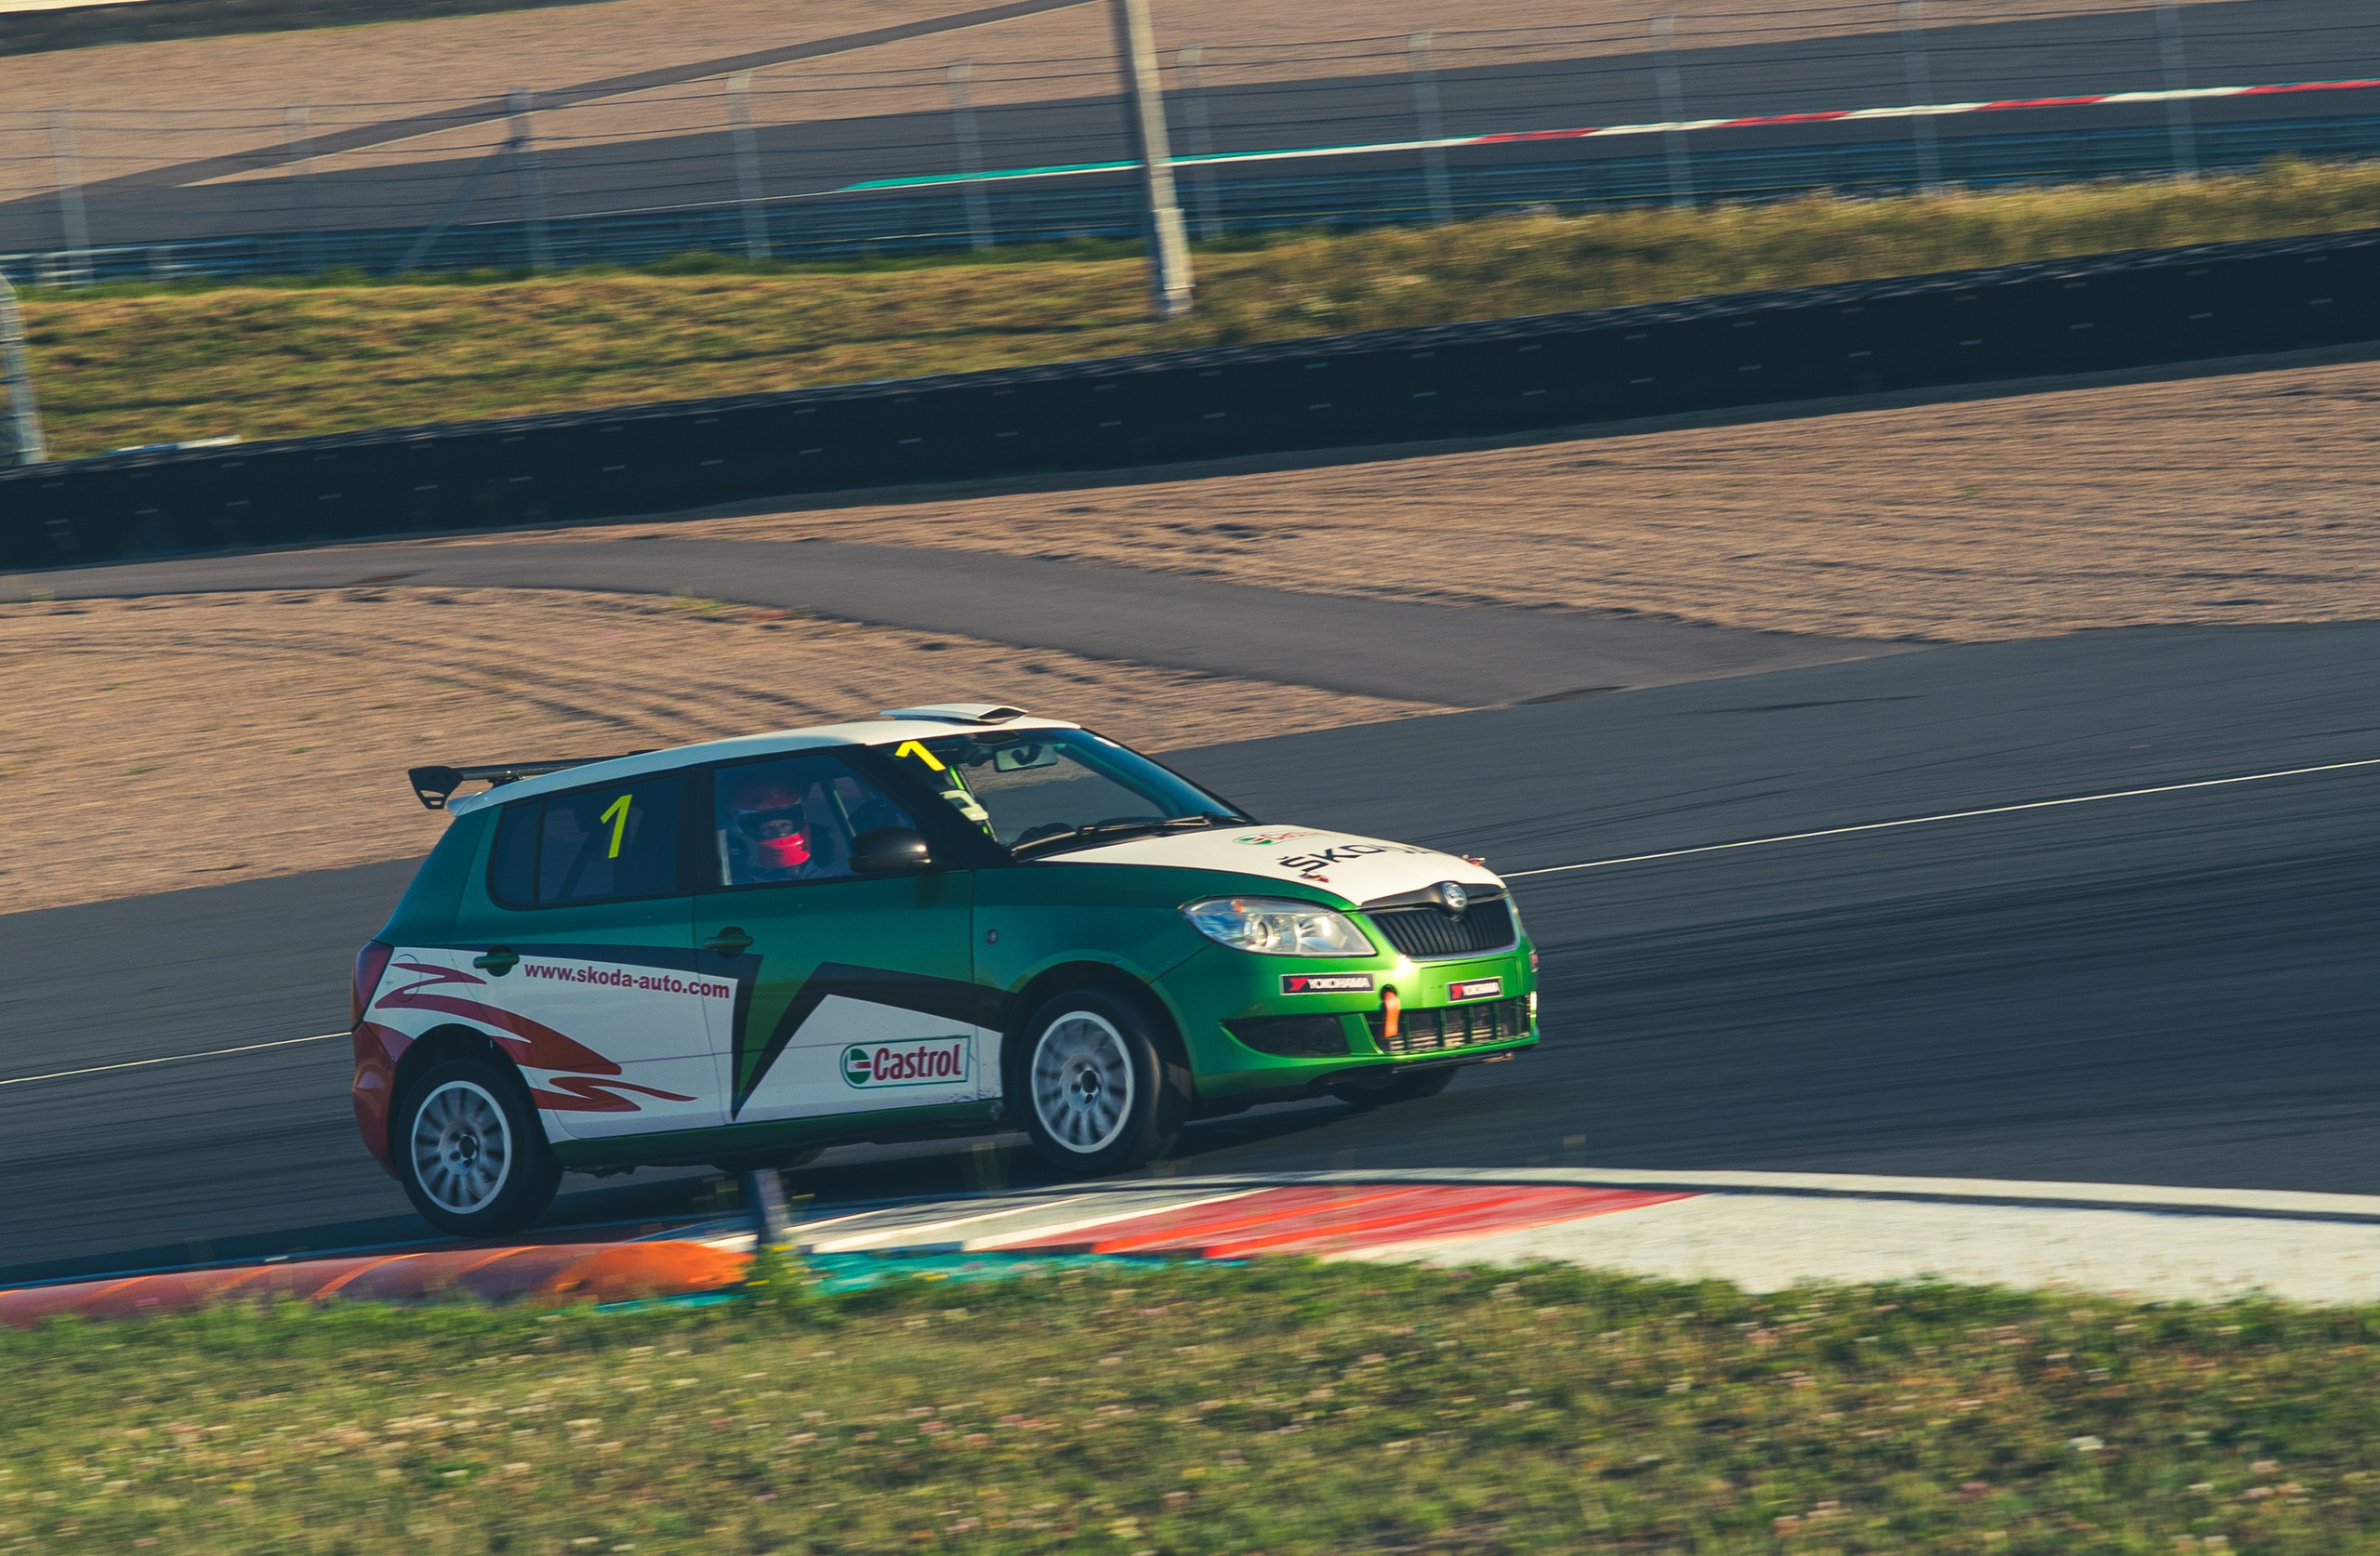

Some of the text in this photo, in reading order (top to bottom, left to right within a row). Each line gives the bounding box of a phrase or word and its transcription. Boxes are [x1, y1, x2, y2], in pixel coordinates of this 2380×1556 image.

[894, 740, 946, 771] 1
[600, 794, 632, 859] 1
[1276, 843, 1446, 873] ŠKO
[524, 963, 730, 999] www.skoda-auto.com
[873, 1043, 962, 1081] Castrol
